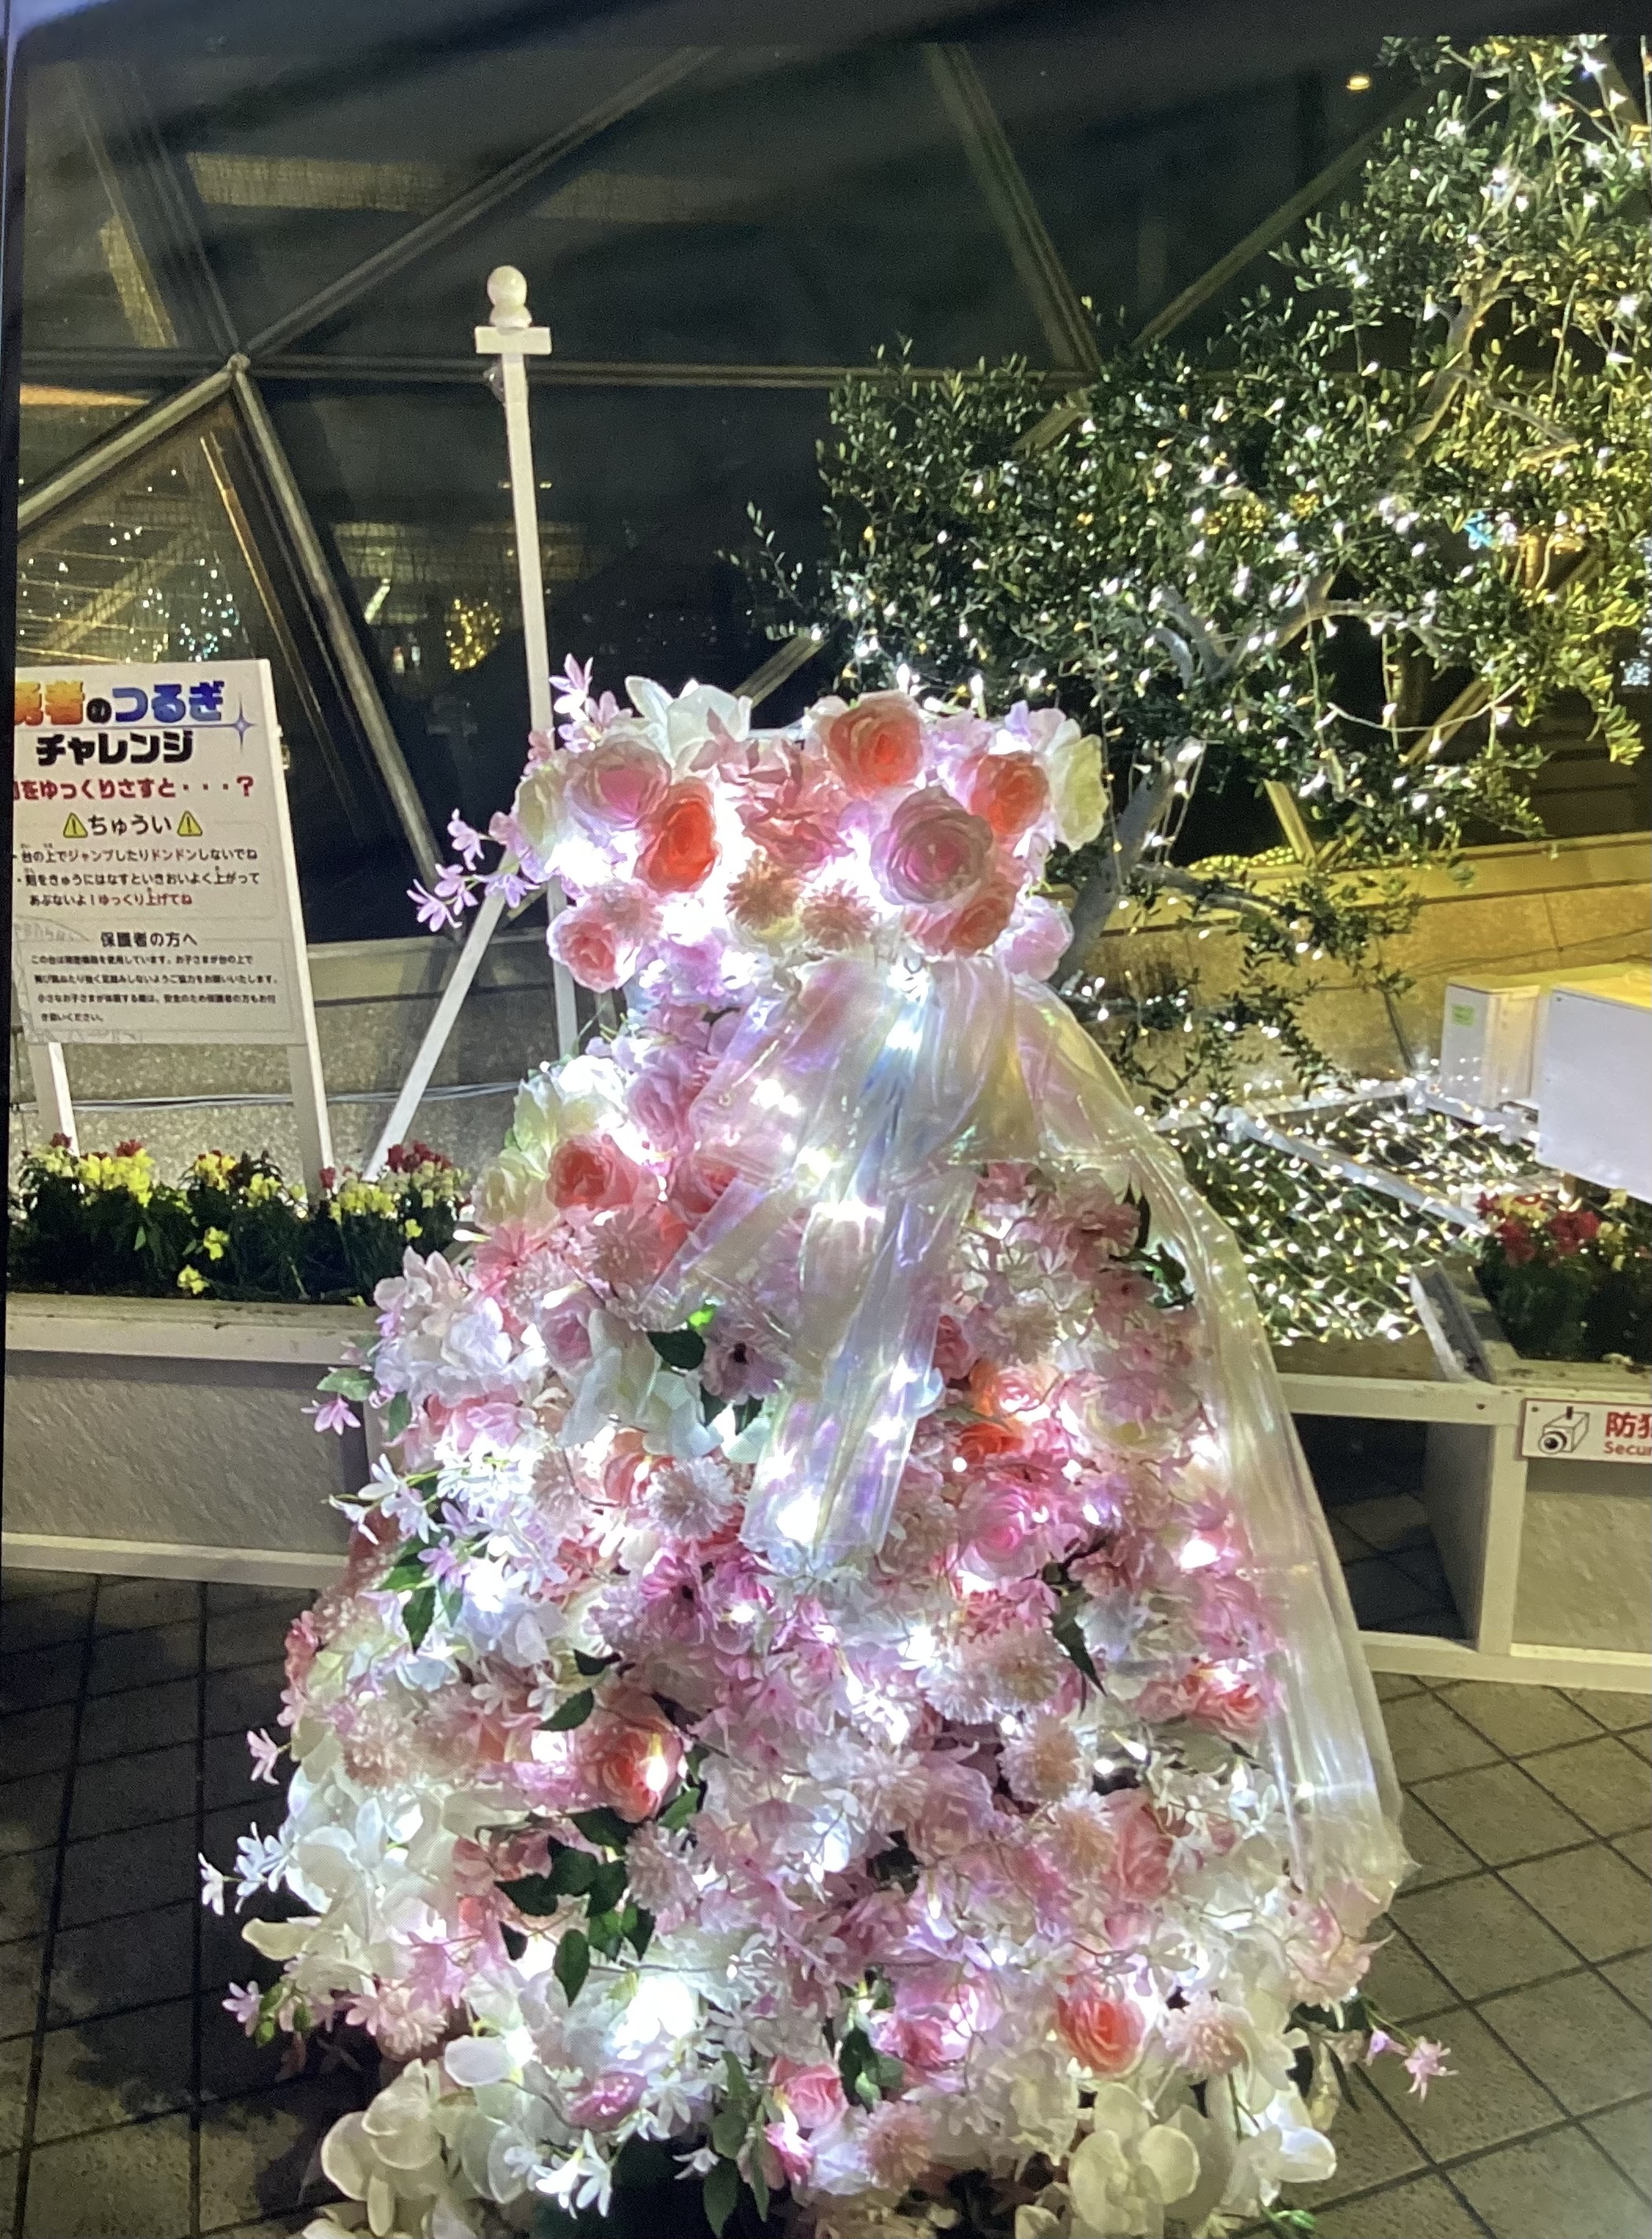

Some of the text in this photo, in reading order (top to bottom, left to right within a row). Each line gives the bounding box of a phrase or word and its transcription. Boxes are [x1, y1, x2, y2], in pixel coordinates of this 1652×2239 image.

[36, 730, 193, 766] チャレンジ
[13, 775, 254, 801] をゆっくりさすと・・・？
[87, 814, 172, 836] ちゅうい
